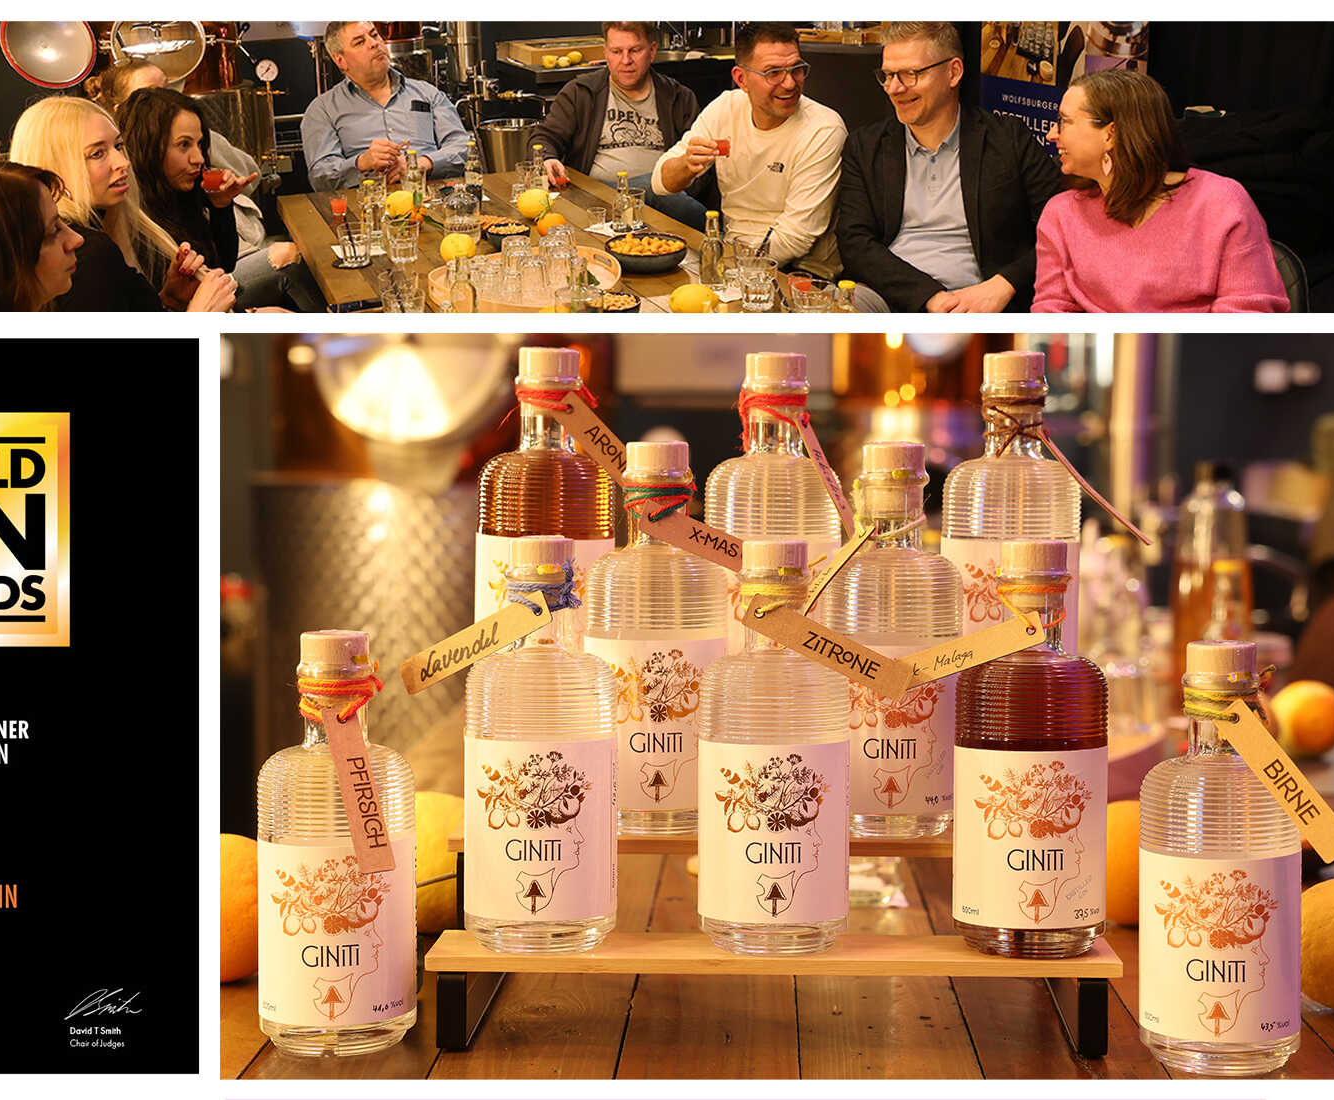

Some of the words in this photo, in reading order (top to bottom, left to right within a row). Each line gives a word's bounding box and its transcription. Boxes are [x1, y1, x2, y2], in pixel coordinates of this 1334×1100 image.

[1002, 93, 1058, 111] WOLFSBURGER
[689, 527, 740, 557] X-MAS
[420, 621, 499, 682] Lavendel
[1263, 759, 1321, 825] BIRNE
[70, 1027, 92, 1035] David
[100, 1027, 121, 1035] Smith
[70, 1039, 89, 1047] Chair
[100, 1039, 124, 1049] Judges
